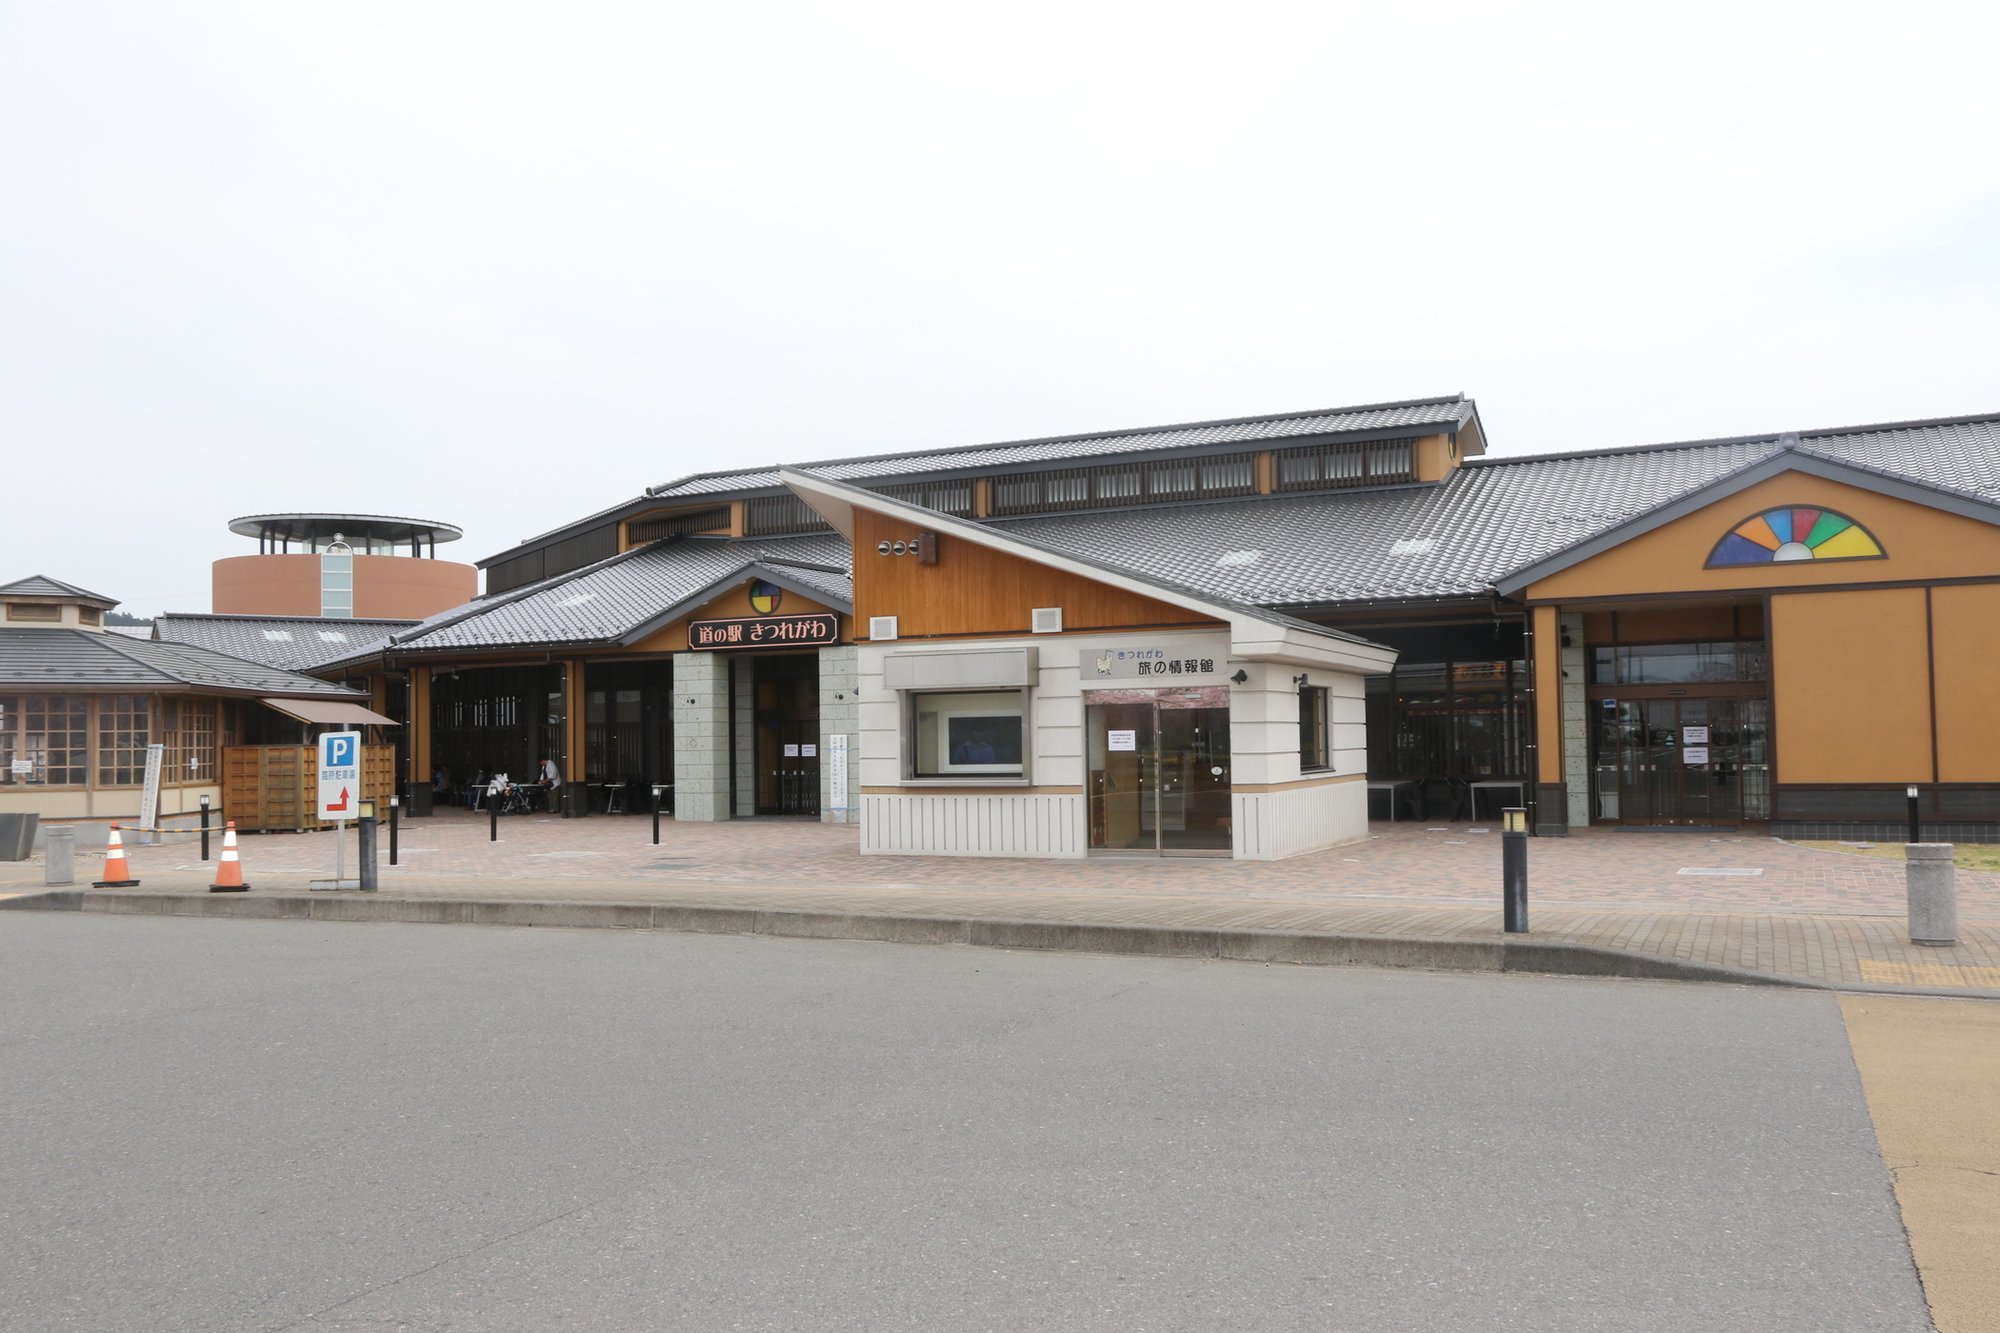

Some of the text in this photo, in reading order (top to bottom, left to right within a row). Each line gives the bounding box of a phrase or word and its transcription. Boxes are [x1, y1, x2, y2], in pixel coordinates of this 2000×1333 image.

[699, 620, 827, 644] 道の駅 きつれがわ
[1117, 649, 1164, 660] きつれがわ
[1138, 659, 1214, 675] 旅の情報館
[333, 739, 348, 764] P
